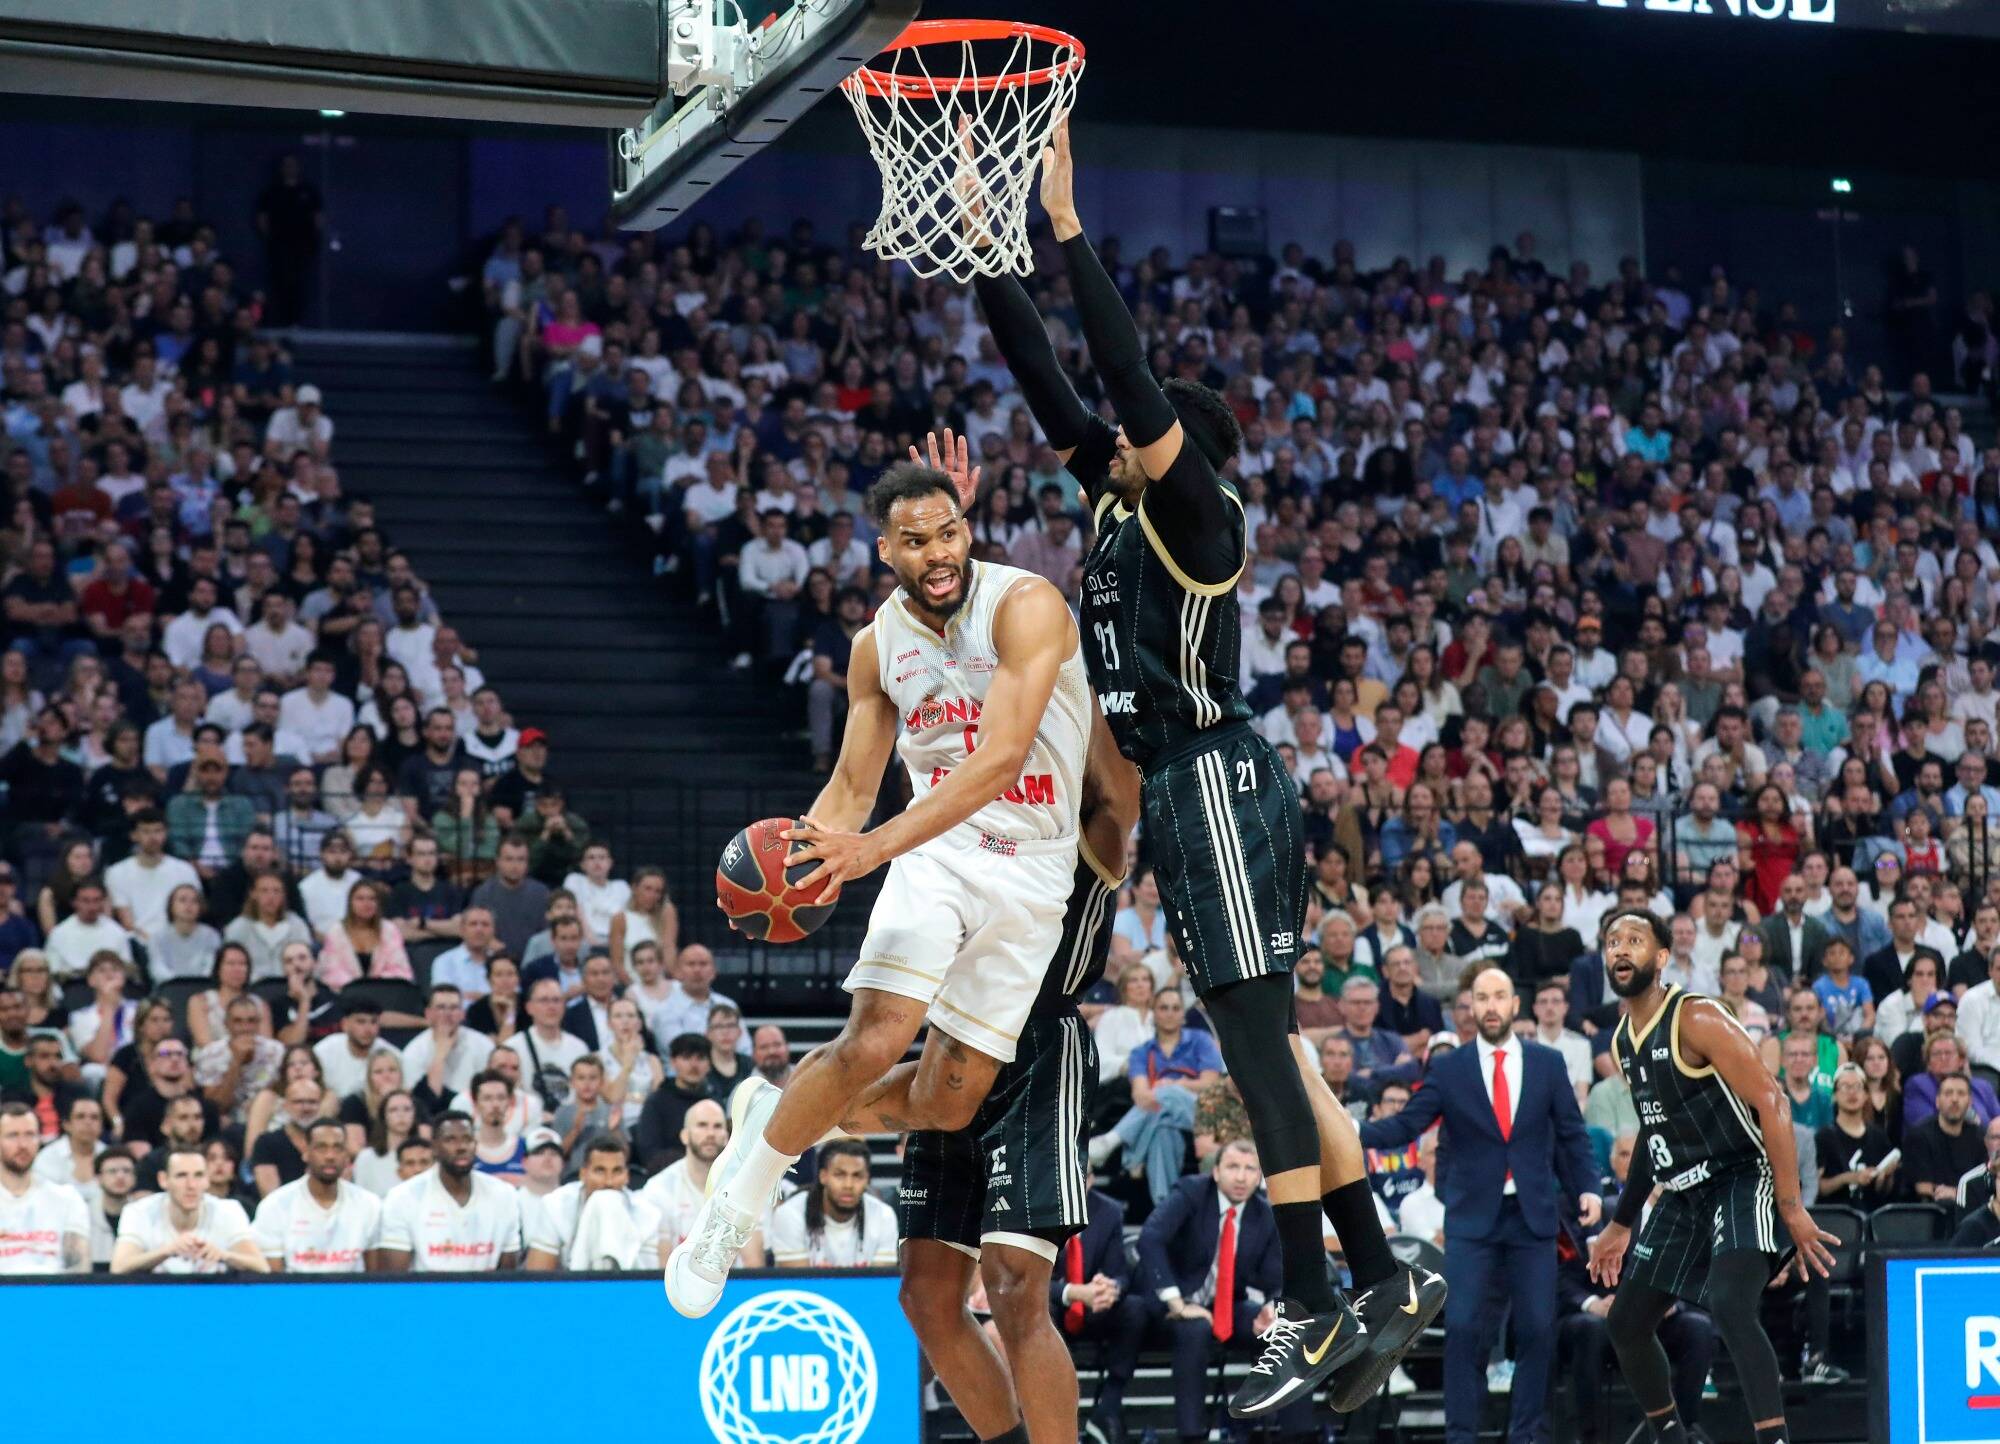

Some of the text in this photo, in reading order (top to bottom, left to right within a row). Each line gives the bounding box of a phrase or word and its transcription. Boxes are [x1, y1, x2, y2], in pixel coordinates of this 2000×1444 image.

[896, 649, 920, 664] SPALDIN
[1093, 620, 1120, 670] 21
[905, 696, 984, 730] MONA
[1236, 758, 1257, 793] 21
[750, 1354, 831, 1413] LNB
